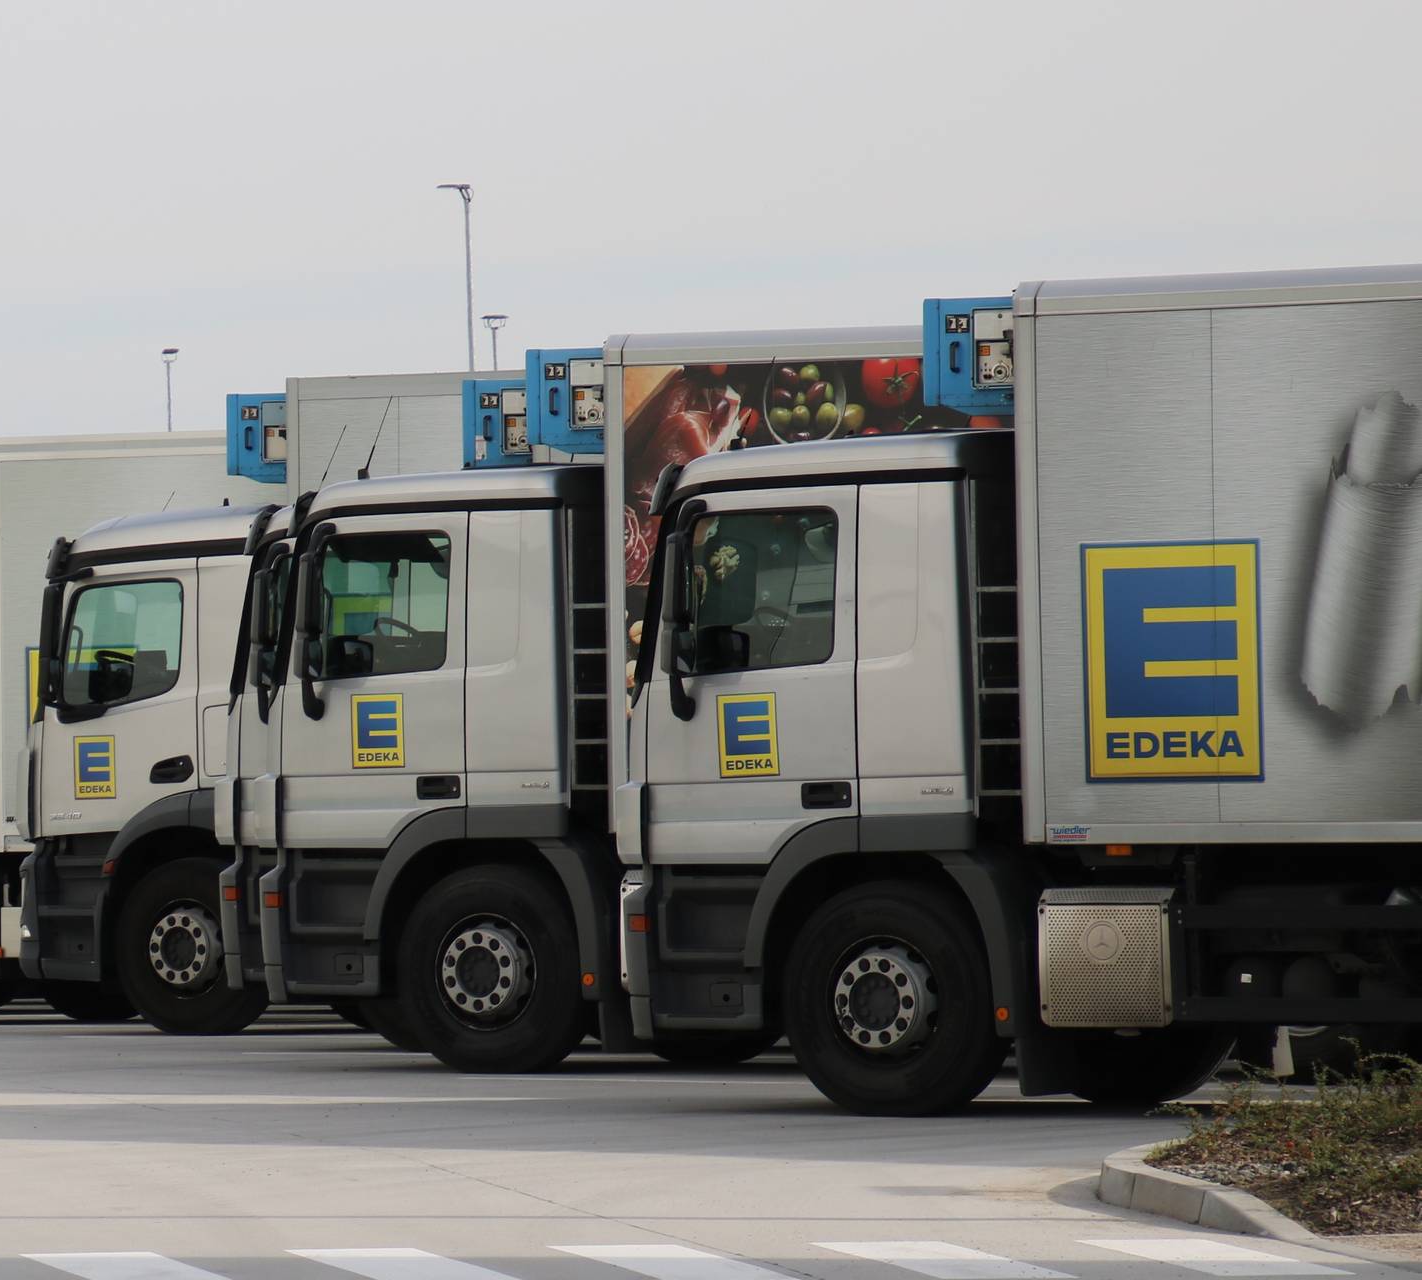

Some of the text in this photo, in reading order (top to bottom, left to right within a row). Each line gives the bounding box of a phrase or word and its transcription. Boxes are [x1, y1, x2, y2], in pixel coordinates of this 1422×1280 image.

[1102, 564, 1239, 718] E
[357, 700, 397, 749] E
[723, 701, 771, 756] E
[358, 752, 399, 762] EDEKA
[1106, 730, 1244, 759] EDEKA
[78, 742, 110, 782] E
[725, 758, 773, 771] EDEKA
[79, 785, 112, 794] EDEKA
